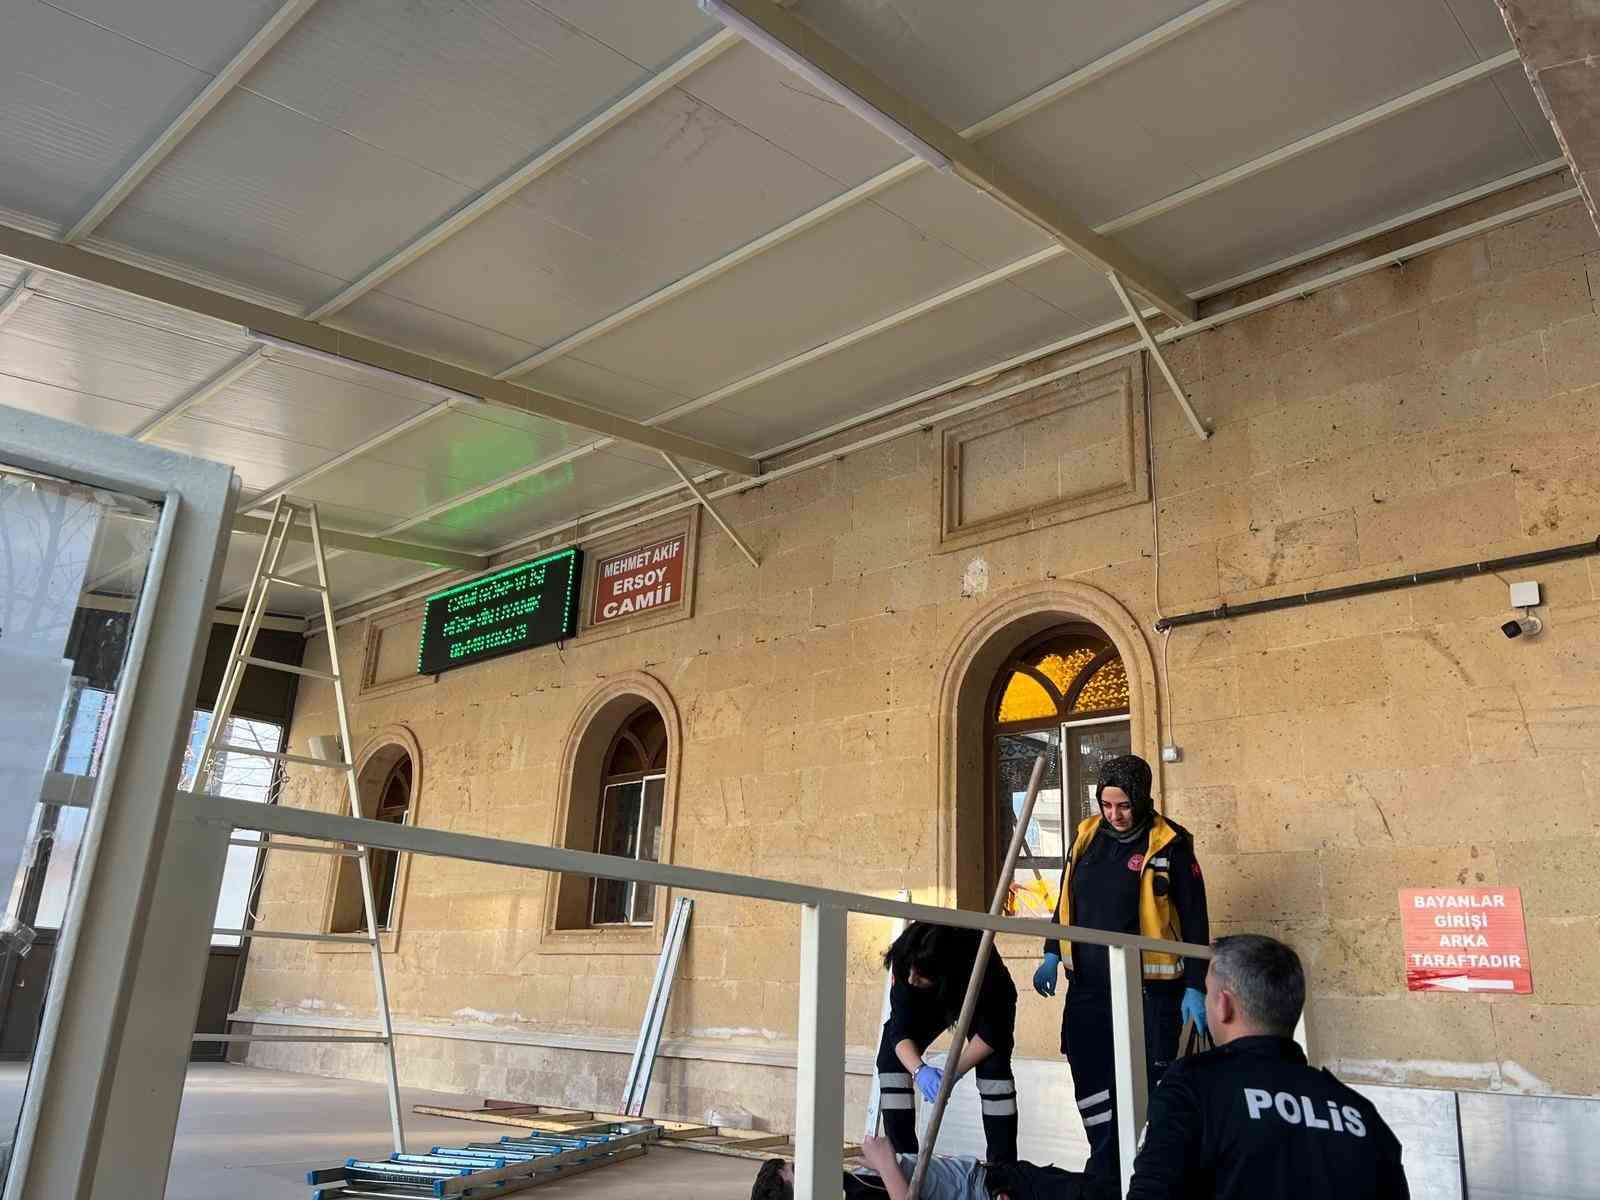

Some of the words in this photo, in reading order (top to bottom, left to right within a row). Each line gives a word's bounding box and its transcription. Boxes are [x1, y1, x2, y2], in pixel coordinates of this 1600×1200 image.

[604, 551, 651, 578] MEHMET
[652, 541, 681, 563] AKİF
[613, 566, 668, 596] ERSOY
[1413, 894, 1505, 908] BAYANLAR
[1434, 911, 1489, 931] GİRİŞİ
[1439, 934, 1489, 948] ARKA
[1412, 953, 1522, 968] TARAFTADIR
